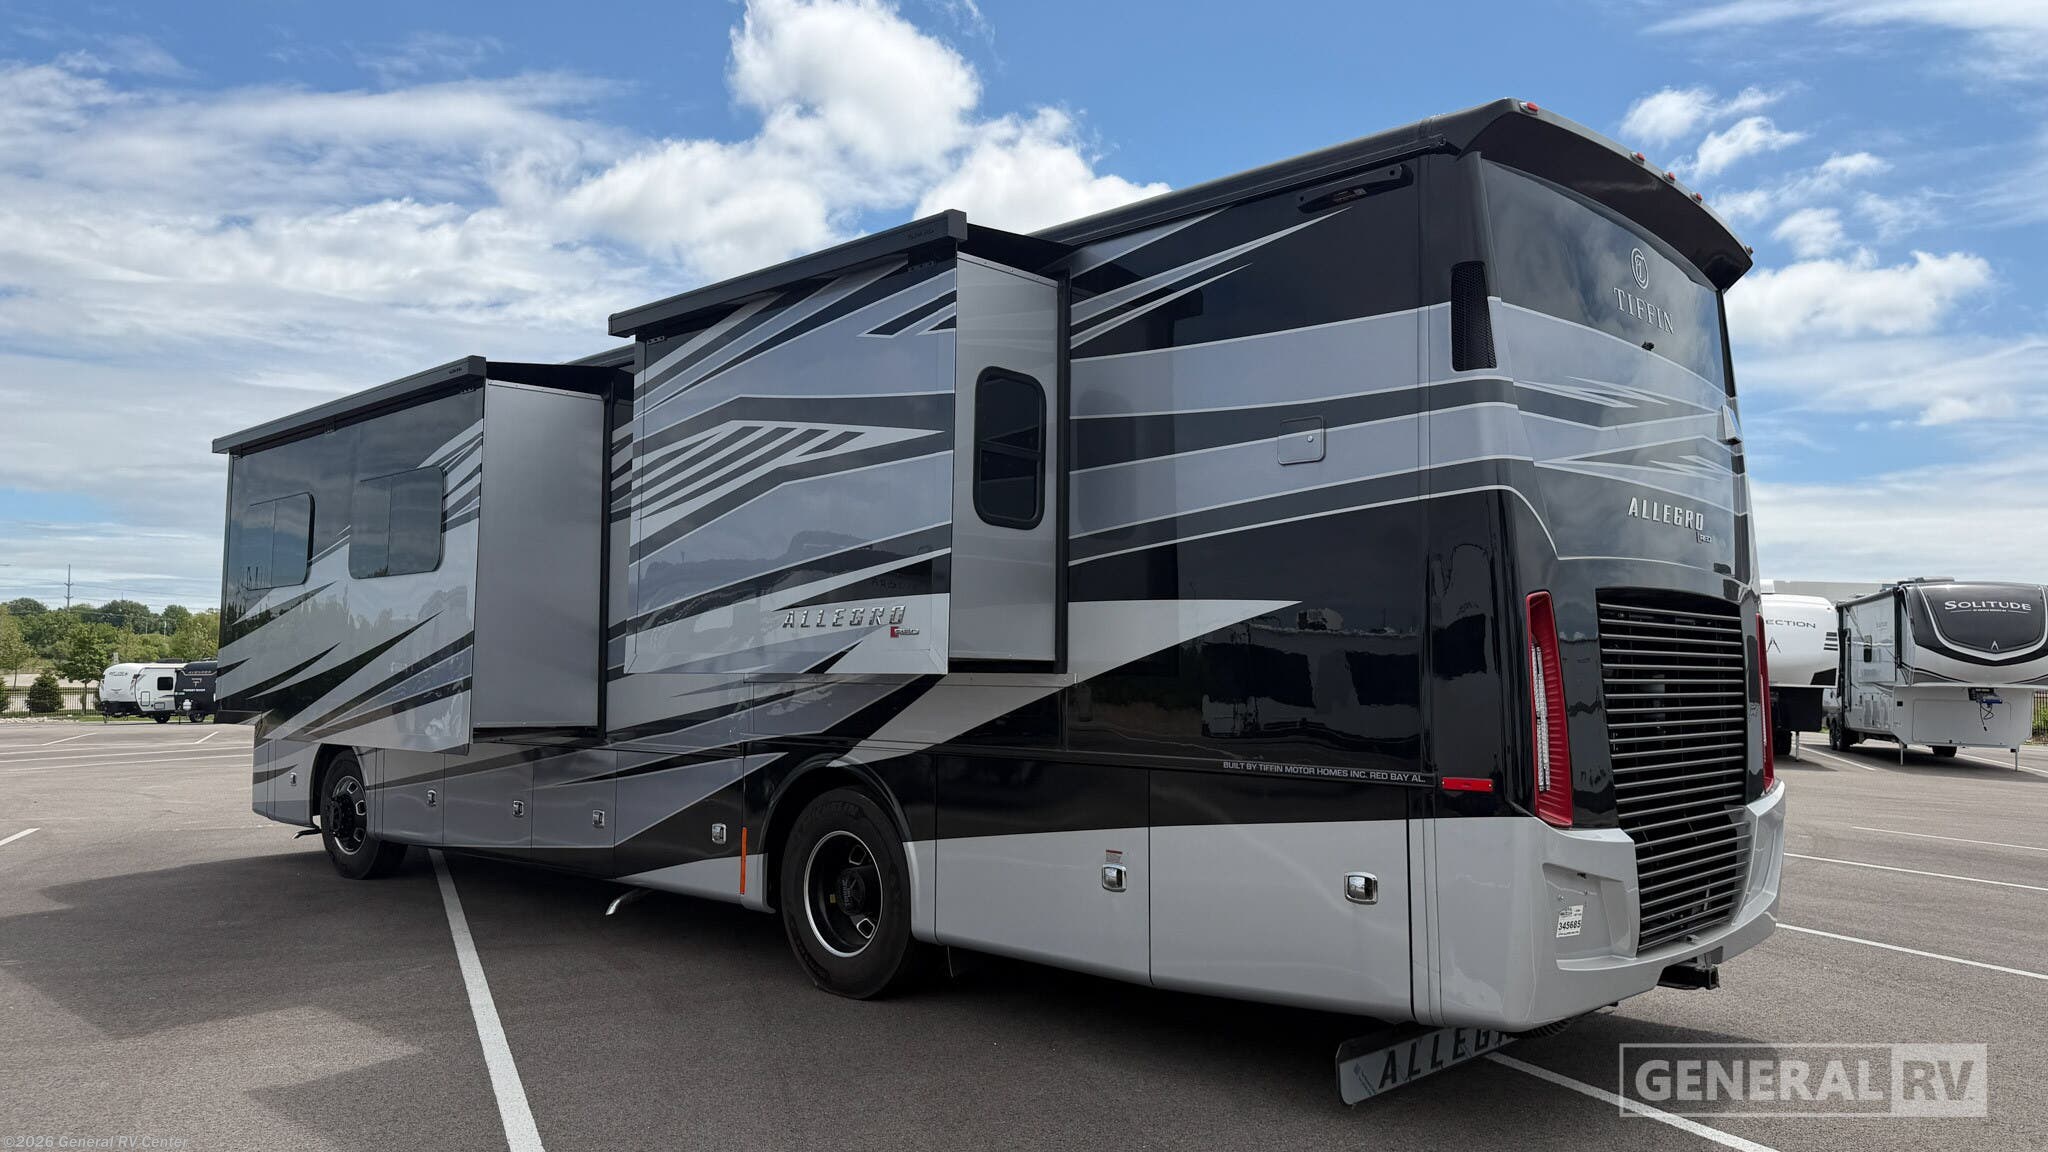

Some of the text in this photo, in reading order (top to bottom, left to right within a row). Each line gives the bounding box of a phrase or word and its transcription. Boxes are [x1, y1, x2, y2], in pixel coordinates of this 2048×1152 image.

[1613, 287, 1674, 334] TIFFIN
[1628, 497, 1704, 531] ALLEGRO
[782, 605, 906, 628] ALLEGRO
[1944, 600, 2032, 611] SOLITUDE
[1223, 761, 1426, 783] BUILT BY TIFFIN MOTOR HOMES INC. RED BAY AL.
[1559, 920, 1581, 930] 345685
